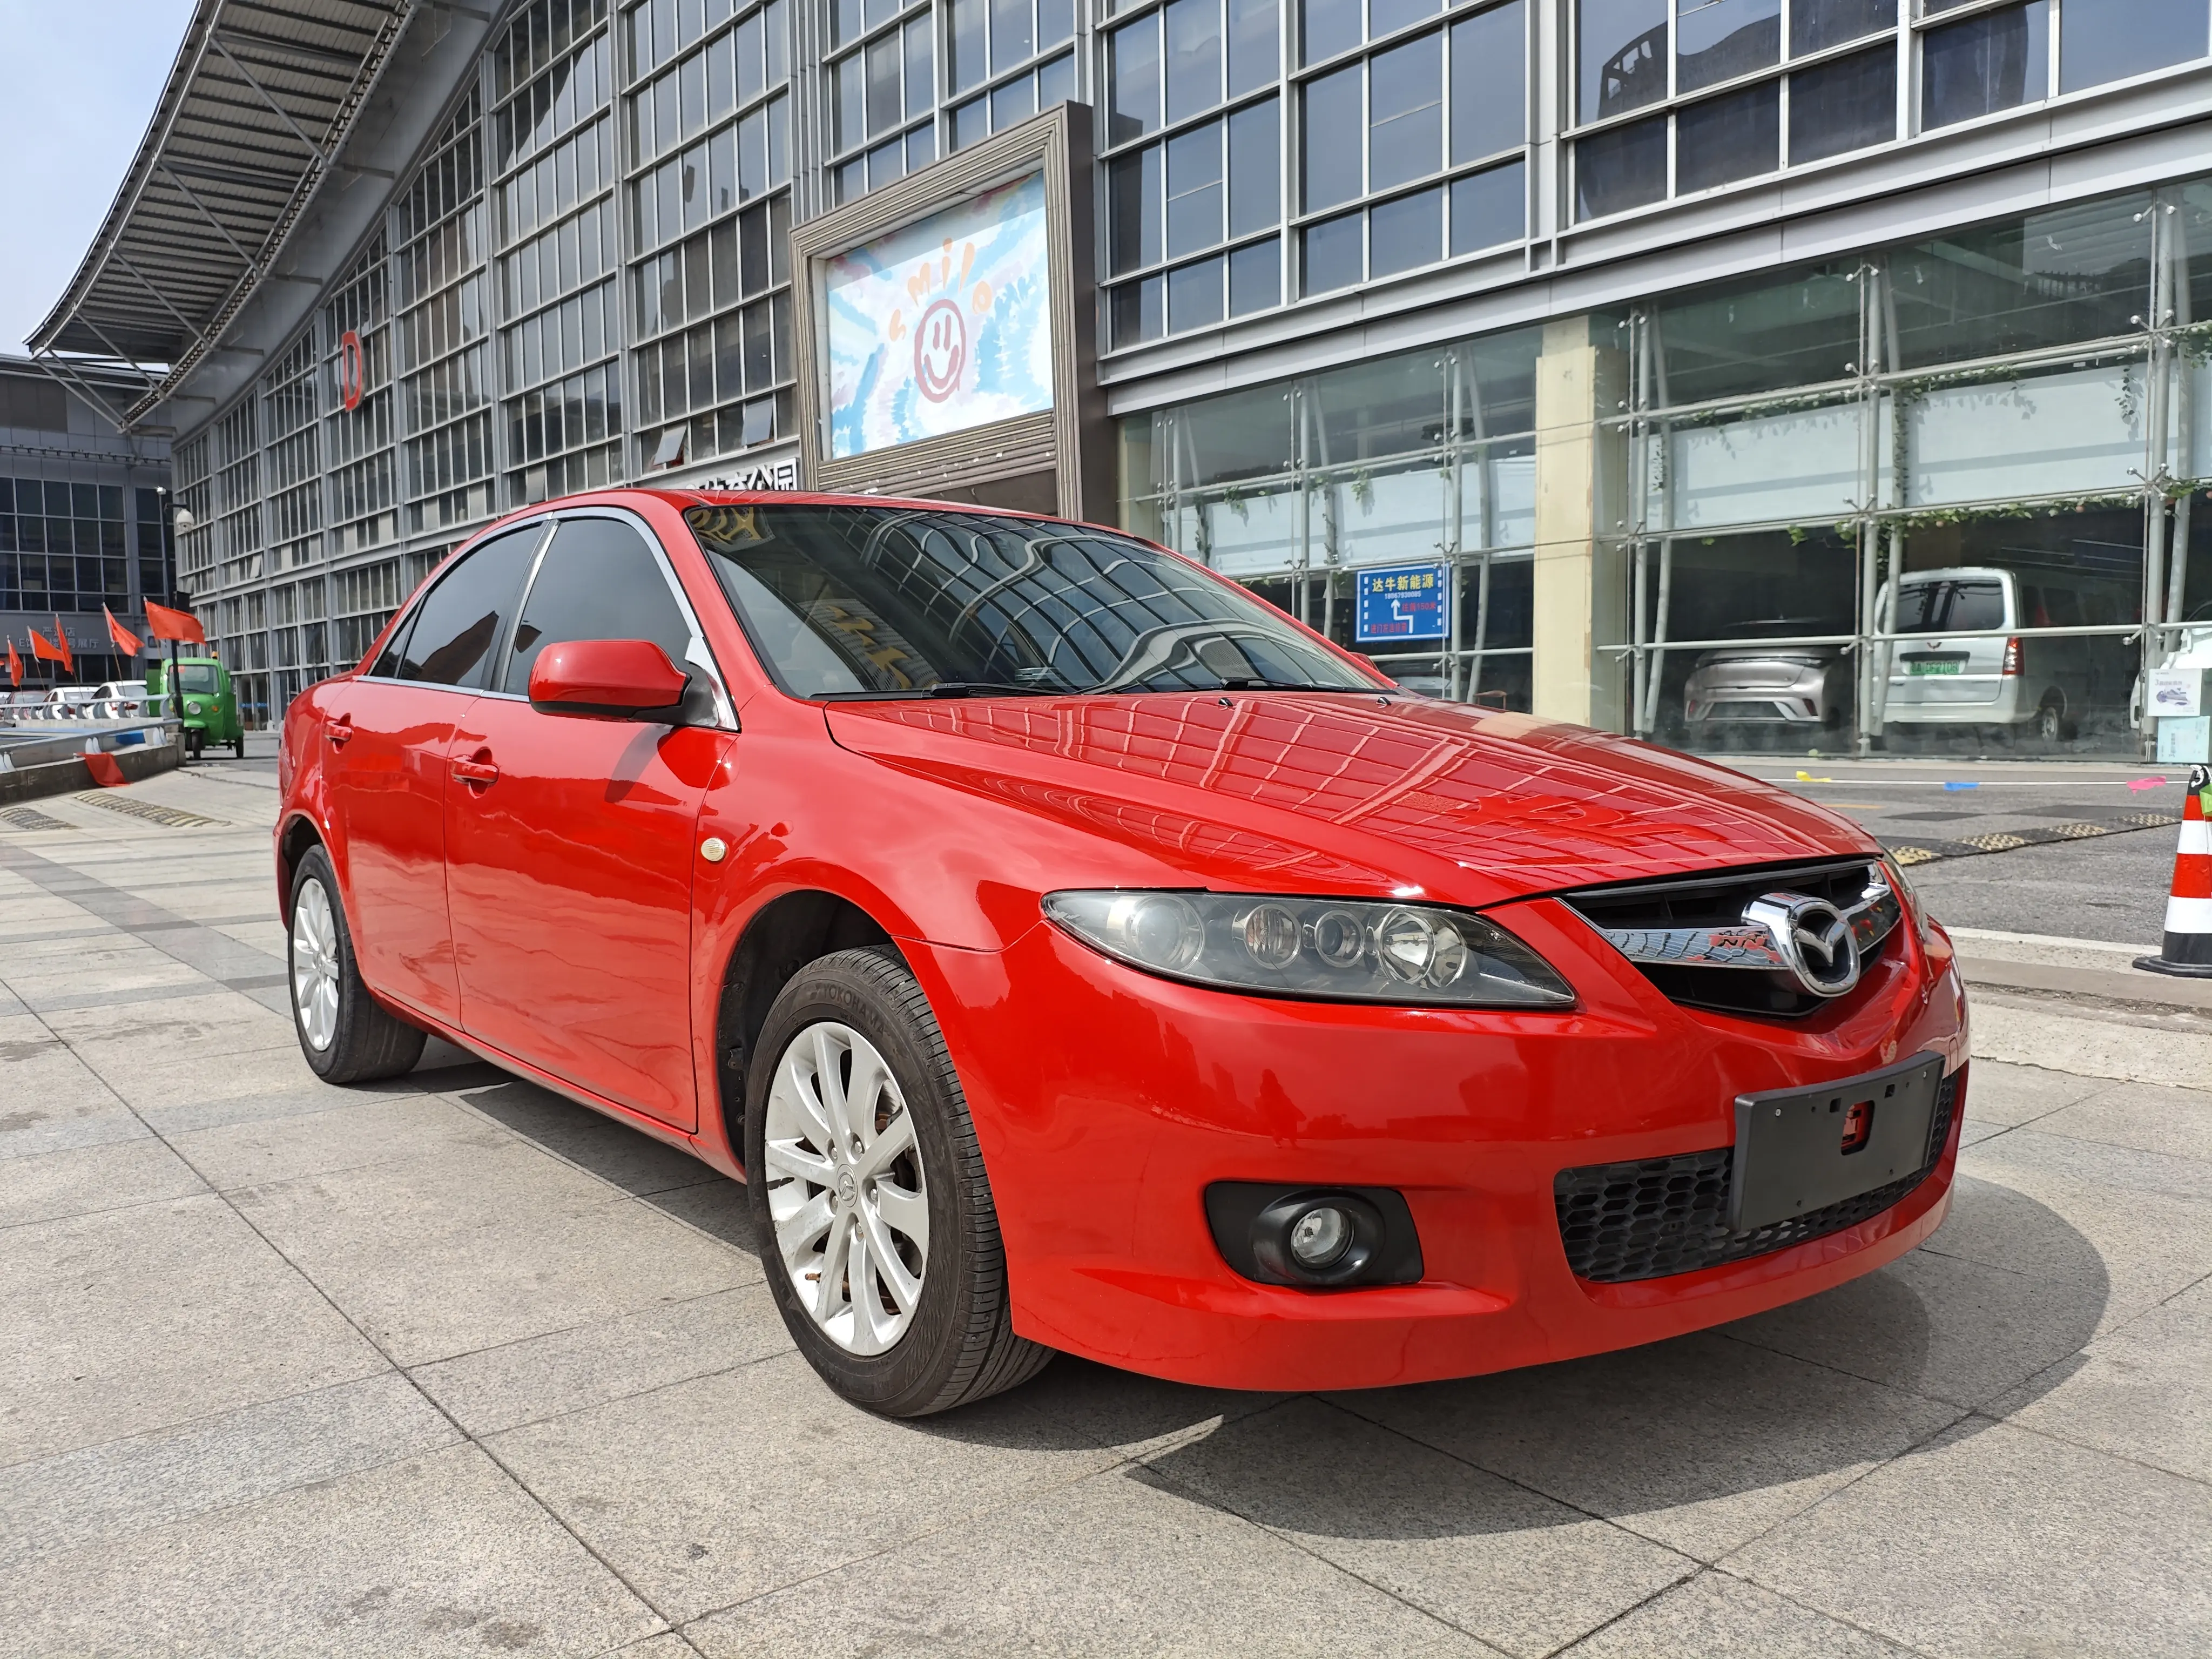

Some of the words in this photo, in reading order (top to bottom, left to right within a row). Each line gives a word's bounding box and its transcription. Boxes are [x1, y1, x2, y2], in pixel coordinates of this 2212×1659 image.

[342, 330, 365, 413] D
[1372, 574, 1434, 592] 达牛新能源
[824, 983, 885, 1035] YOKOHAMA
